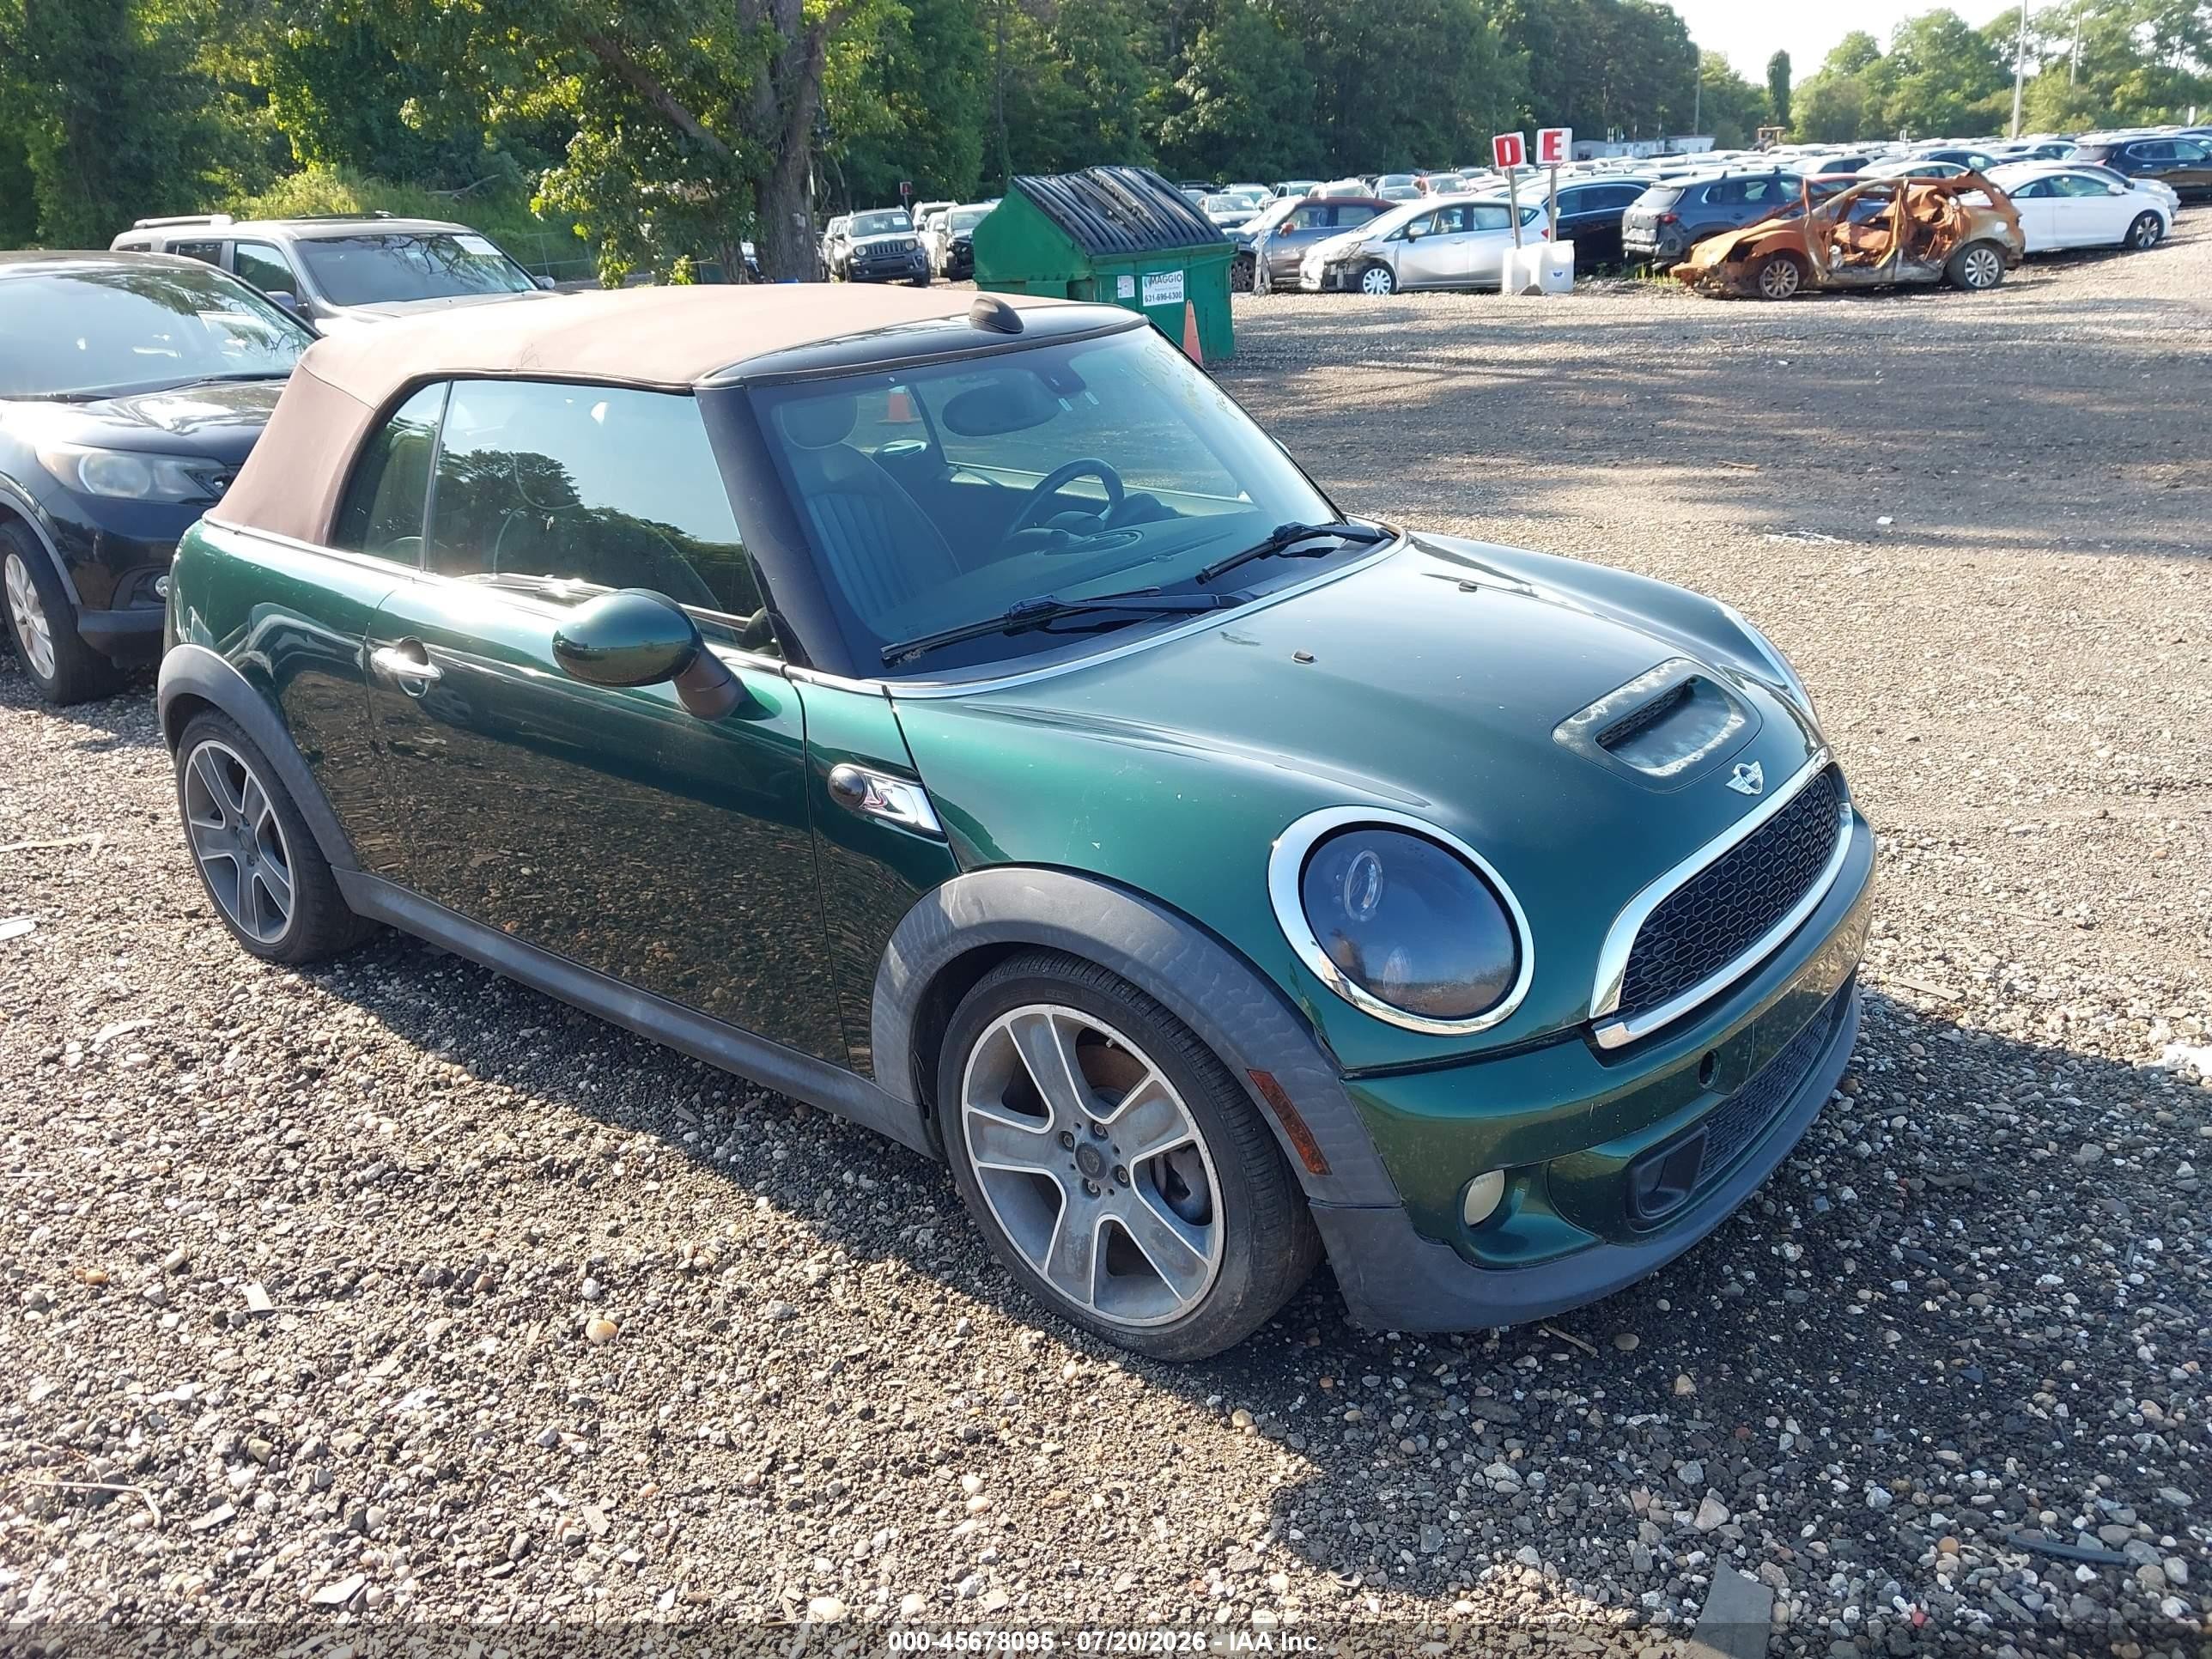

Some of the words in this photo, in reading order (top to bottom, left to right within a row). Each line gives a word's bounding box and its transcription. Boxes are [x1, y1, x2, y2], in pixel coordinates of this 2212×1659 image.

[1495, 137, 1522, 167] D
[1542, 131, 1563, 161] E
[1150, 273, 1182, 285] MAGGIO
